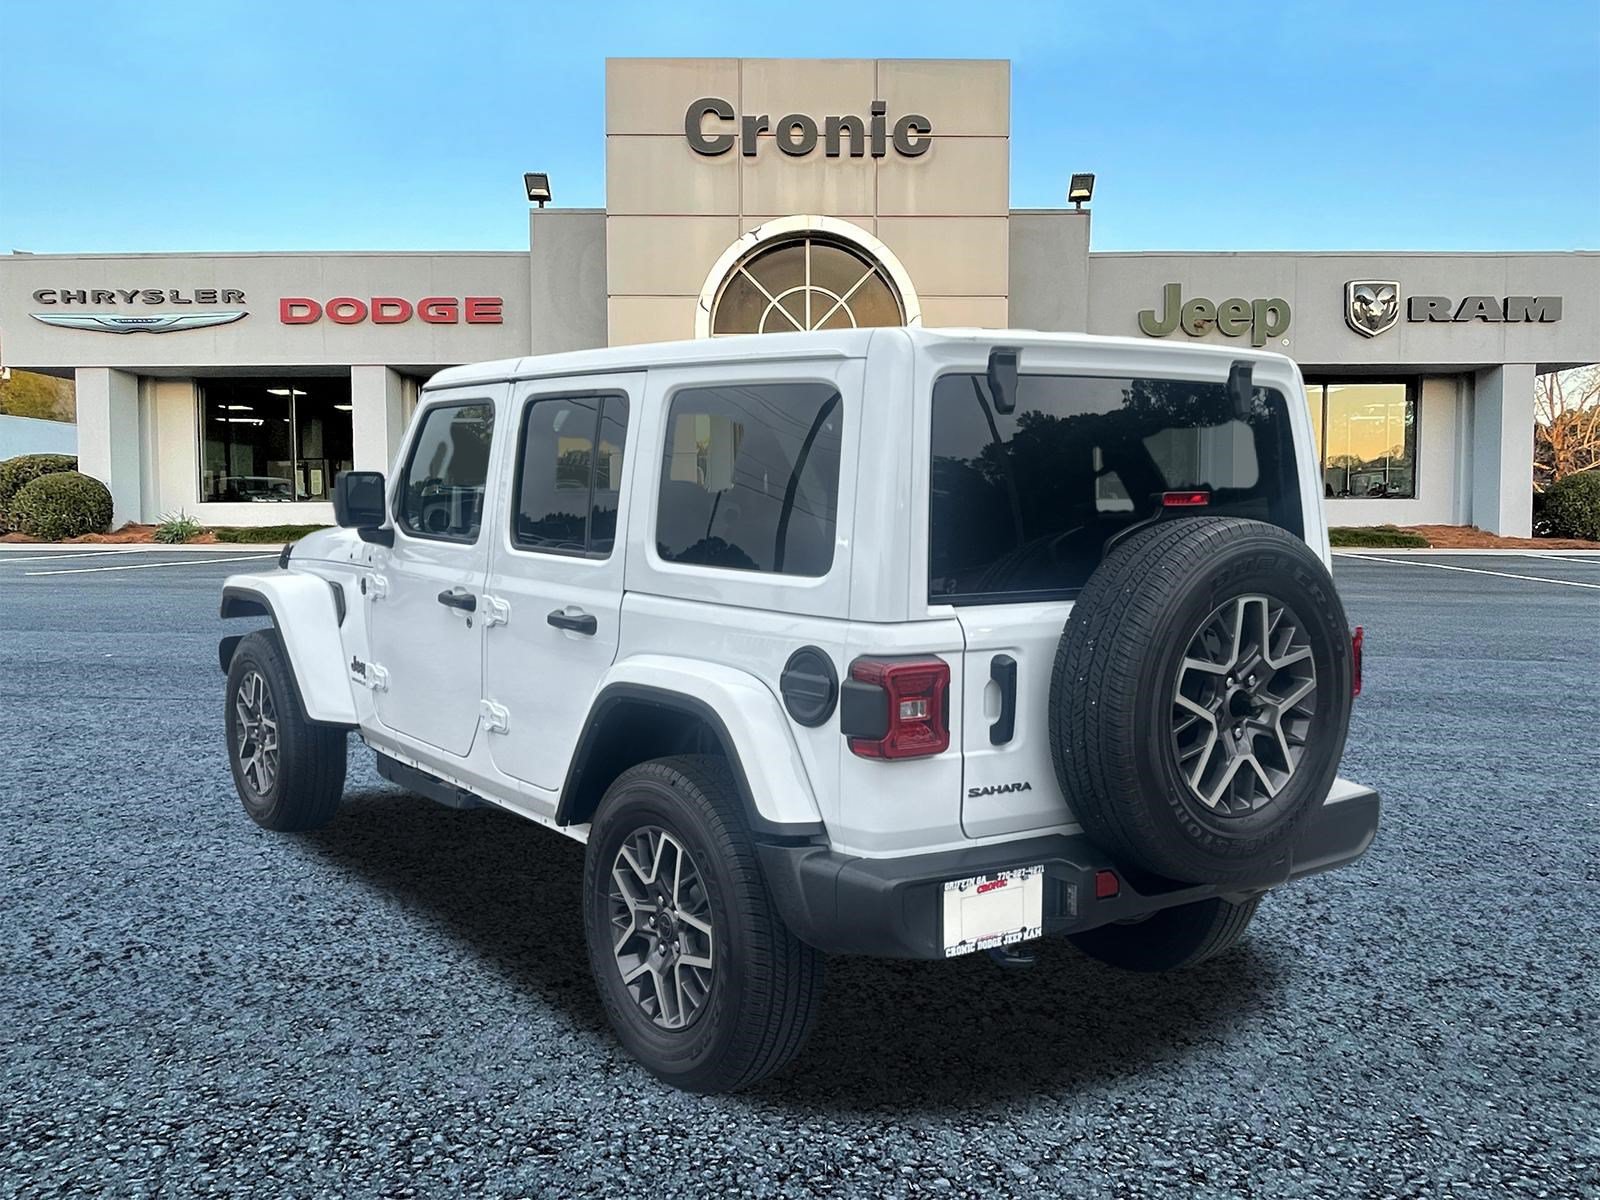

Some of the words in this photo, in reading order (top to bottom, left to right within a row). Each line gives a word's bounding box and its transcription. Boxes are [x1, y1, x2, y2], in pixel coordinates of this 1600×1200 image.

[684, 97, 933, 158] Cronic
[32, 288, 247, 305] CHRYSLER
[1407, 296, 1562, 323] RAM
[280, 297, 504, 325] DODGE
[1138, 283, 1292, 347] Jeep
[968, 781, 1033, 798] SAHARA
[946, 943, 976, 957] CRONIC
[977, 937, 1002, 950] DODGE
[1003, 931, 1023, 945] JEEP
